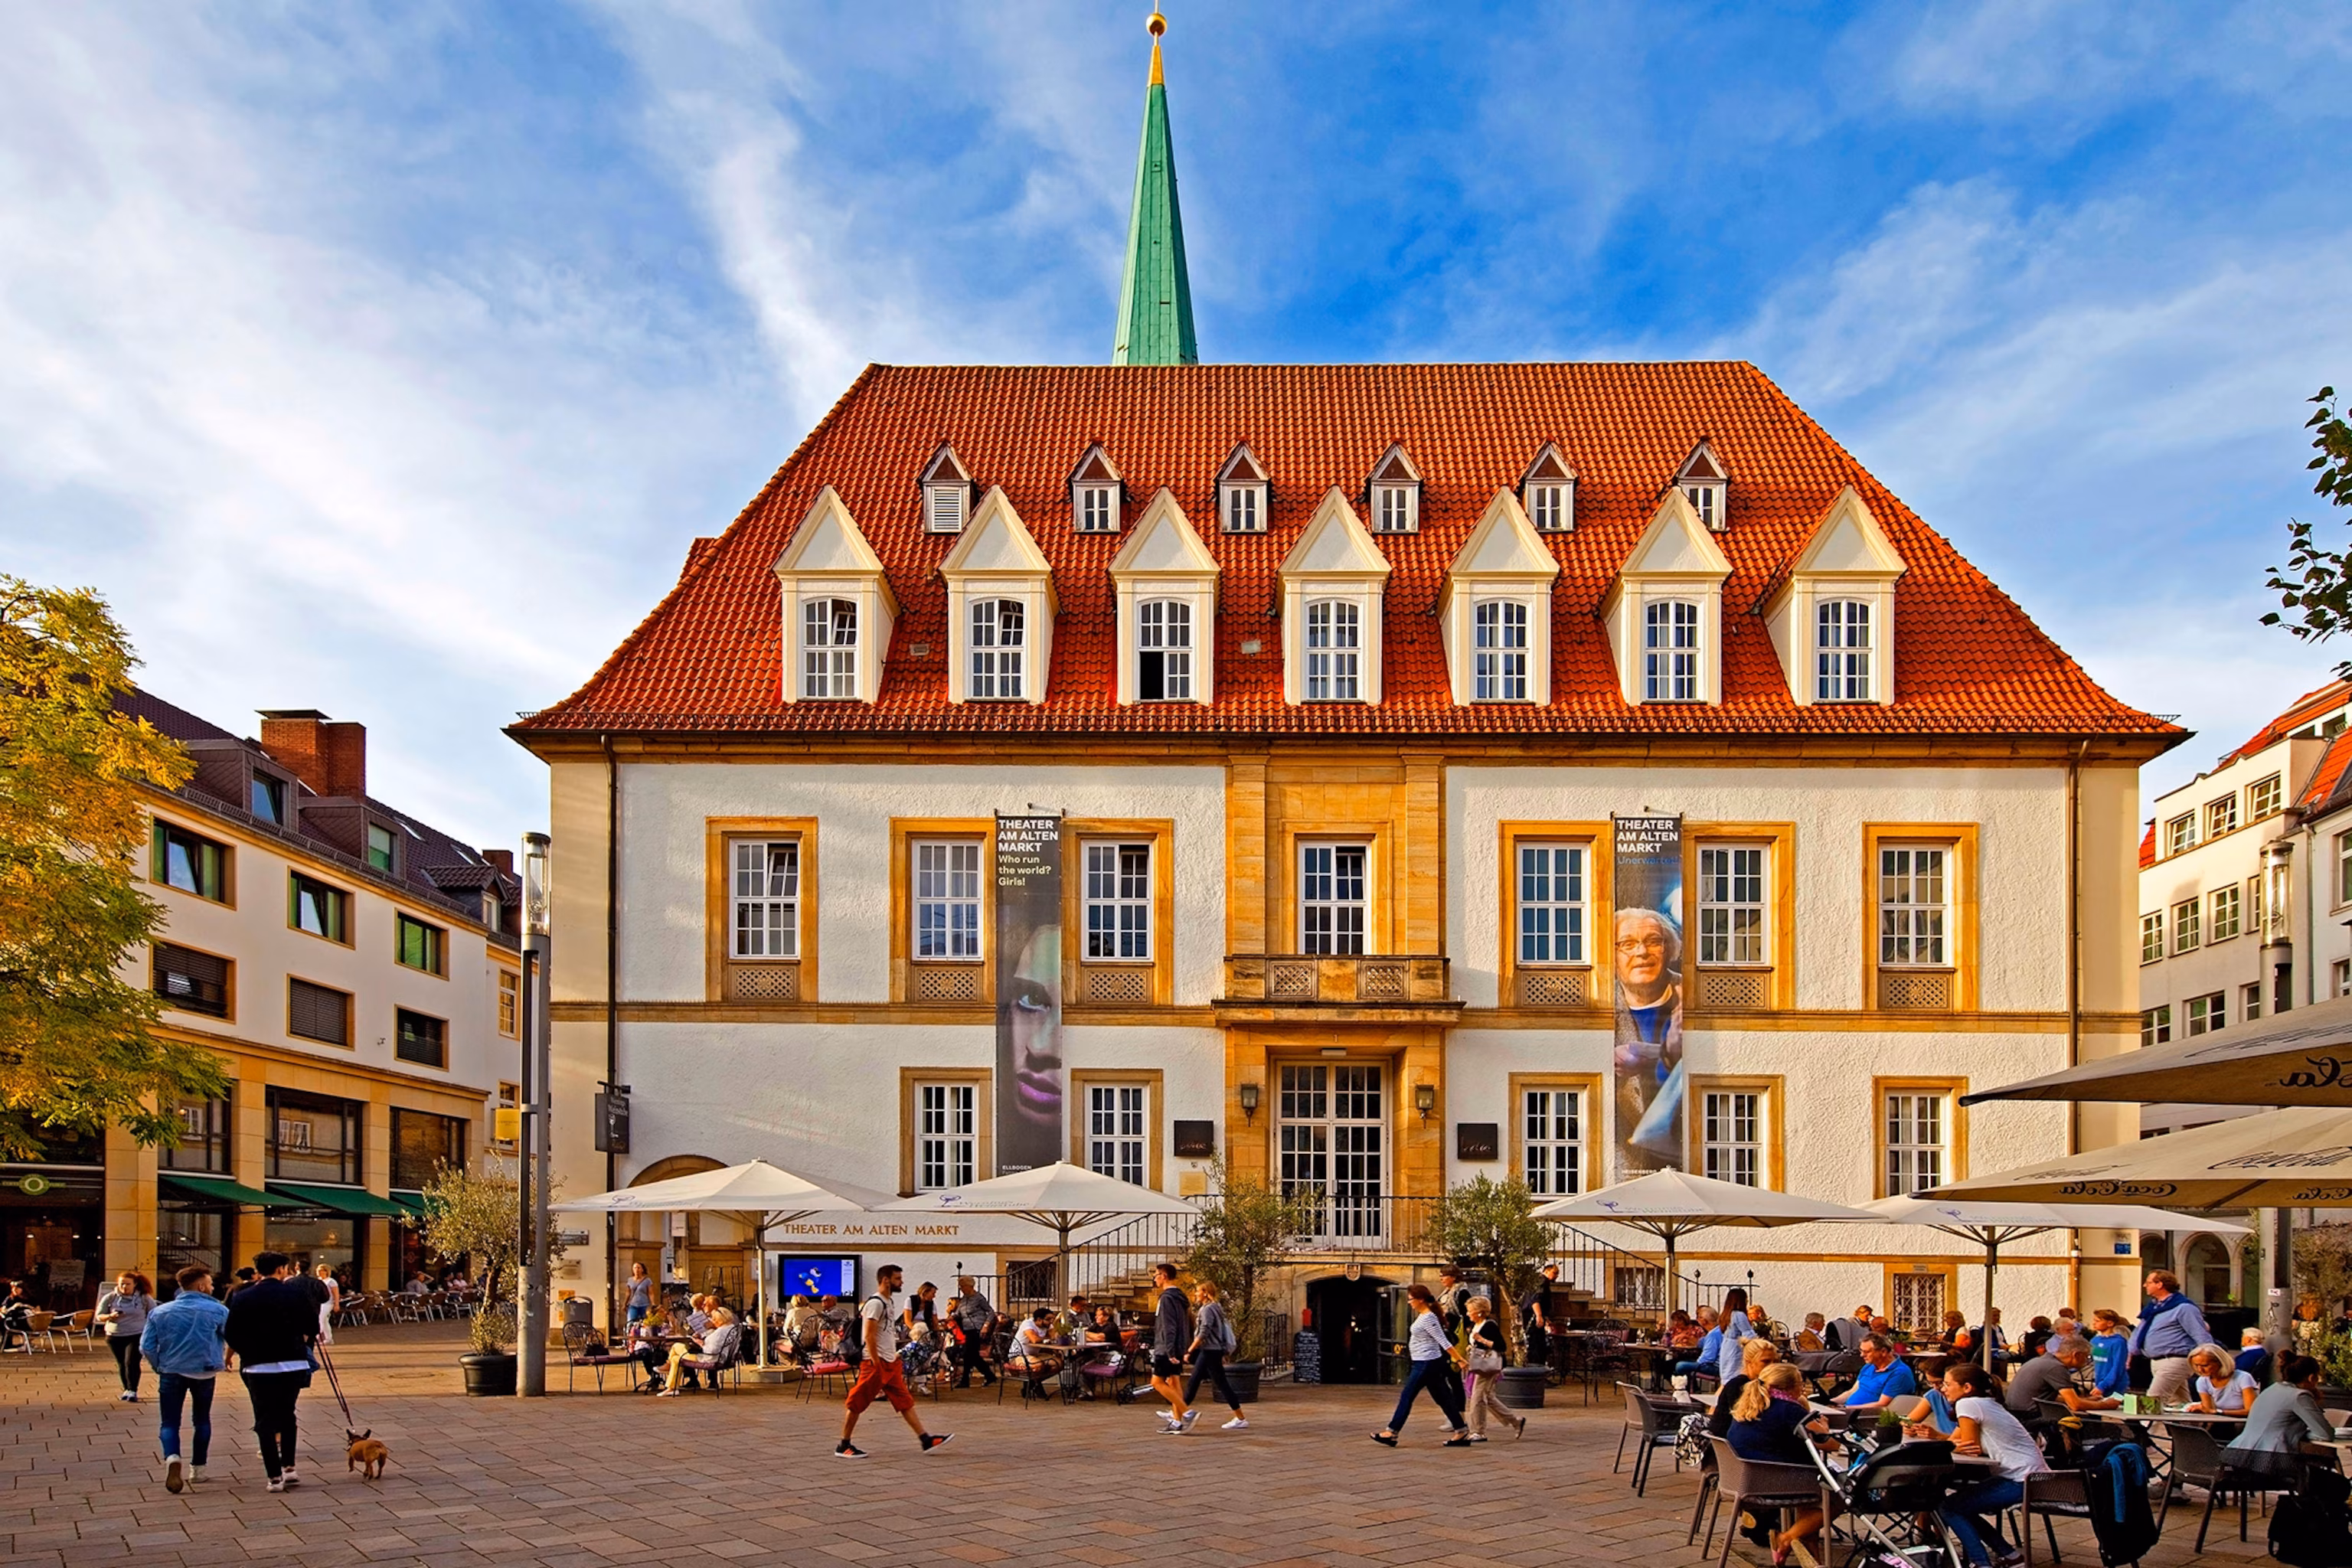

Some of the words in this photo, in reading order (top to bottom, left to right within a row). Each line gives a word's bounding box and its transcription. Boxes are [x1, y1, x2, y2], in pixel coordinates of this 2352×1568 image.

[998, 819, 1054, 829] THEATER
[1617, 820, 1674, 830] THEATER
[998, 831, 1017, 841] AM
[1019, 831, 1059, 841] ALTEN
[1616, 831, 1636, 841] AM
[1638, 831, 1679, 841] ALTEN
[998, 842, 1043, 852] MARKT
[1617, 843, 1662, 853] MARKT
[998, 854, 1021, 864] Who
[998, 865, 1016, 874] the
[1018, 865, 1052, 874] world?
[998, 877, 1026, 886] Girls!
[783, 1223, 838, 1235] THEATER
[843, 1224, 864, 1235] AM
[869, 1224, 908, 1235] ALTEN
[915, 1225, 959, 1236] MARKT
